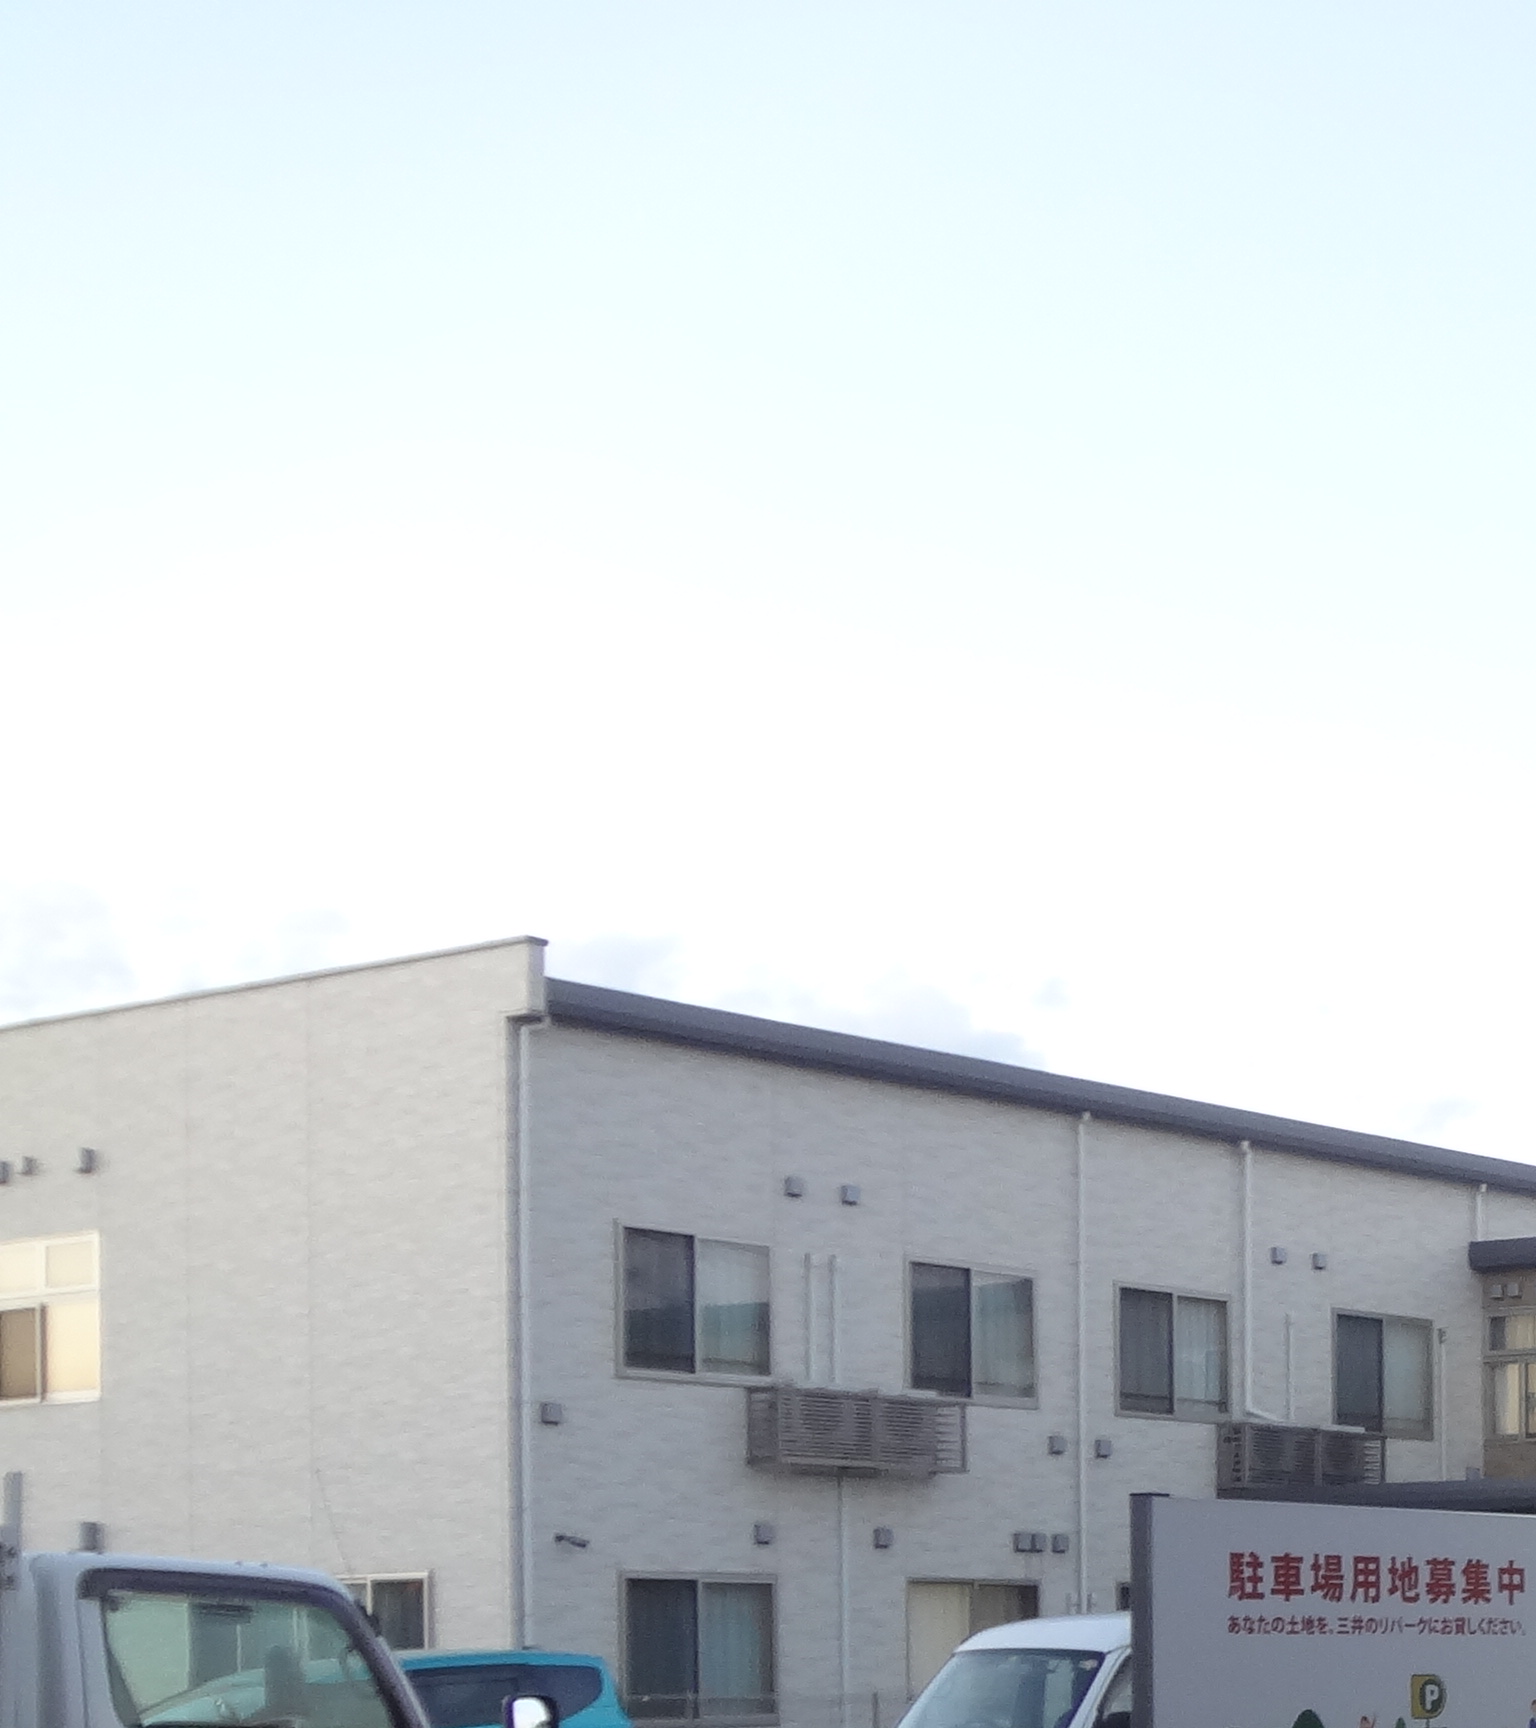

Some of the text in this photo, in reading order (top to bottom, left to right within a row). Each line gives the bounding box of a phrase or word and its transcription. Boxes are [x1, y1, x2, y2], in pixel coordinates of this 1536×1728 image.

[1227, 1551, 1527, 1606] 駐車場用地募集中
